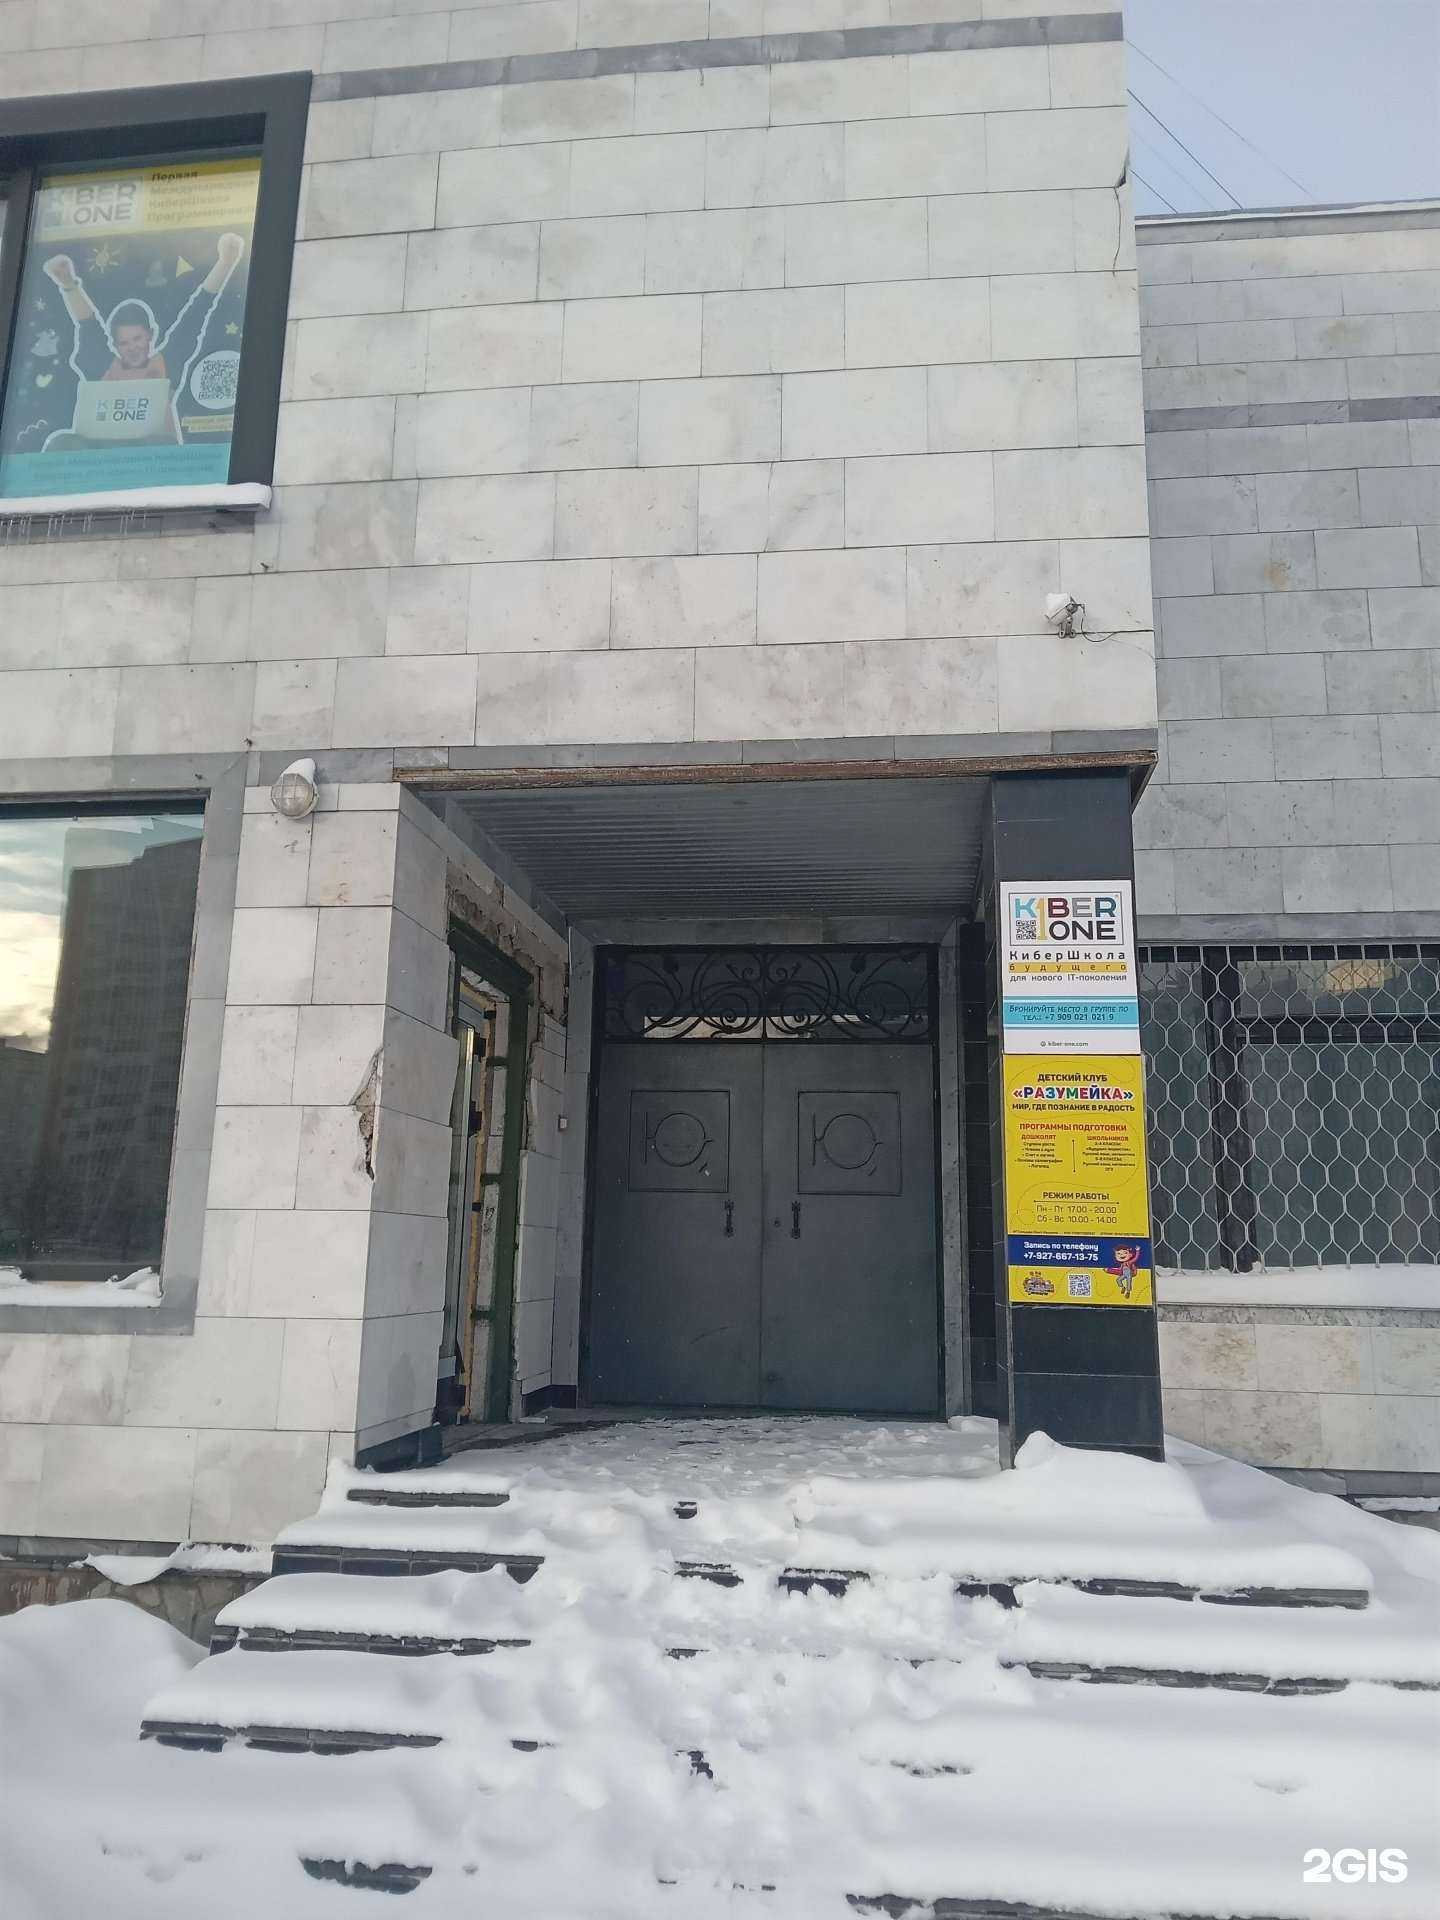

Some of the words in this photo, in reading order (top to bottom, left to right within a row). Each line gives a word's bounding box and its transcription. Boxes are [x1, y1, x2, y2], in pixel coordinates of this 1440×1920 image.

[73, 203, 134, 225] ONE
[112, 410, 147, 422] ONE
[1048, 920, 1117, 941] ONE
[1009, 950, 1126, 962] КиберШкола
[1009, 963, 1127, 972] будущего
[1044, 1013, 1054, 1021] +7
[1057, 1013, 1072, 1021] 909
[1074, 1013, 1088, 1021] 021
[1091, 1013, 1106, 1021] 021
[1108, 1013, 1114, 1021] 9
[1037, 1072, 1081, 1083] ДЕТСКИЙ
[1082, 1074, 1108, 1083] КЛУБ
[1012, 1084, 1135, 1101] «РАЗУМЕЙКА»
[1011, 1103, 1031, 1112] МИР,
[1032, 1103, 1047, 1112] ГДЕ
[1048, 1103, 1090, 1112] ПОЗНАНИЕ
[1091, 1104, 1097, 1112] В
[1098, 1104, 1136, 1113] РАДОСТЬ
[1019, 1123, 1072, 1132] ПРОГРАММЫ
[1072, 1124, 1127, 1133] ПОДГОТОВКИ
[1042, 1191, 1074, 1200] РЕЖИМ
[1075, 1192, 1110, 1200] РАБОТЫ
[1036, 1205, 1047, 1213] Пн
[1055, 1205, 1064, 1213] Пт
[1036, 1215, 1048, 1223] Сб
[1054, 1215, 1064, 1223] Вс
[1023, 1241, 1051, 1249] Запись
[1062, 1242, 1099, 1252] телефону
[1023, 1251, 1099, 1262] +7-927-667-13-75
